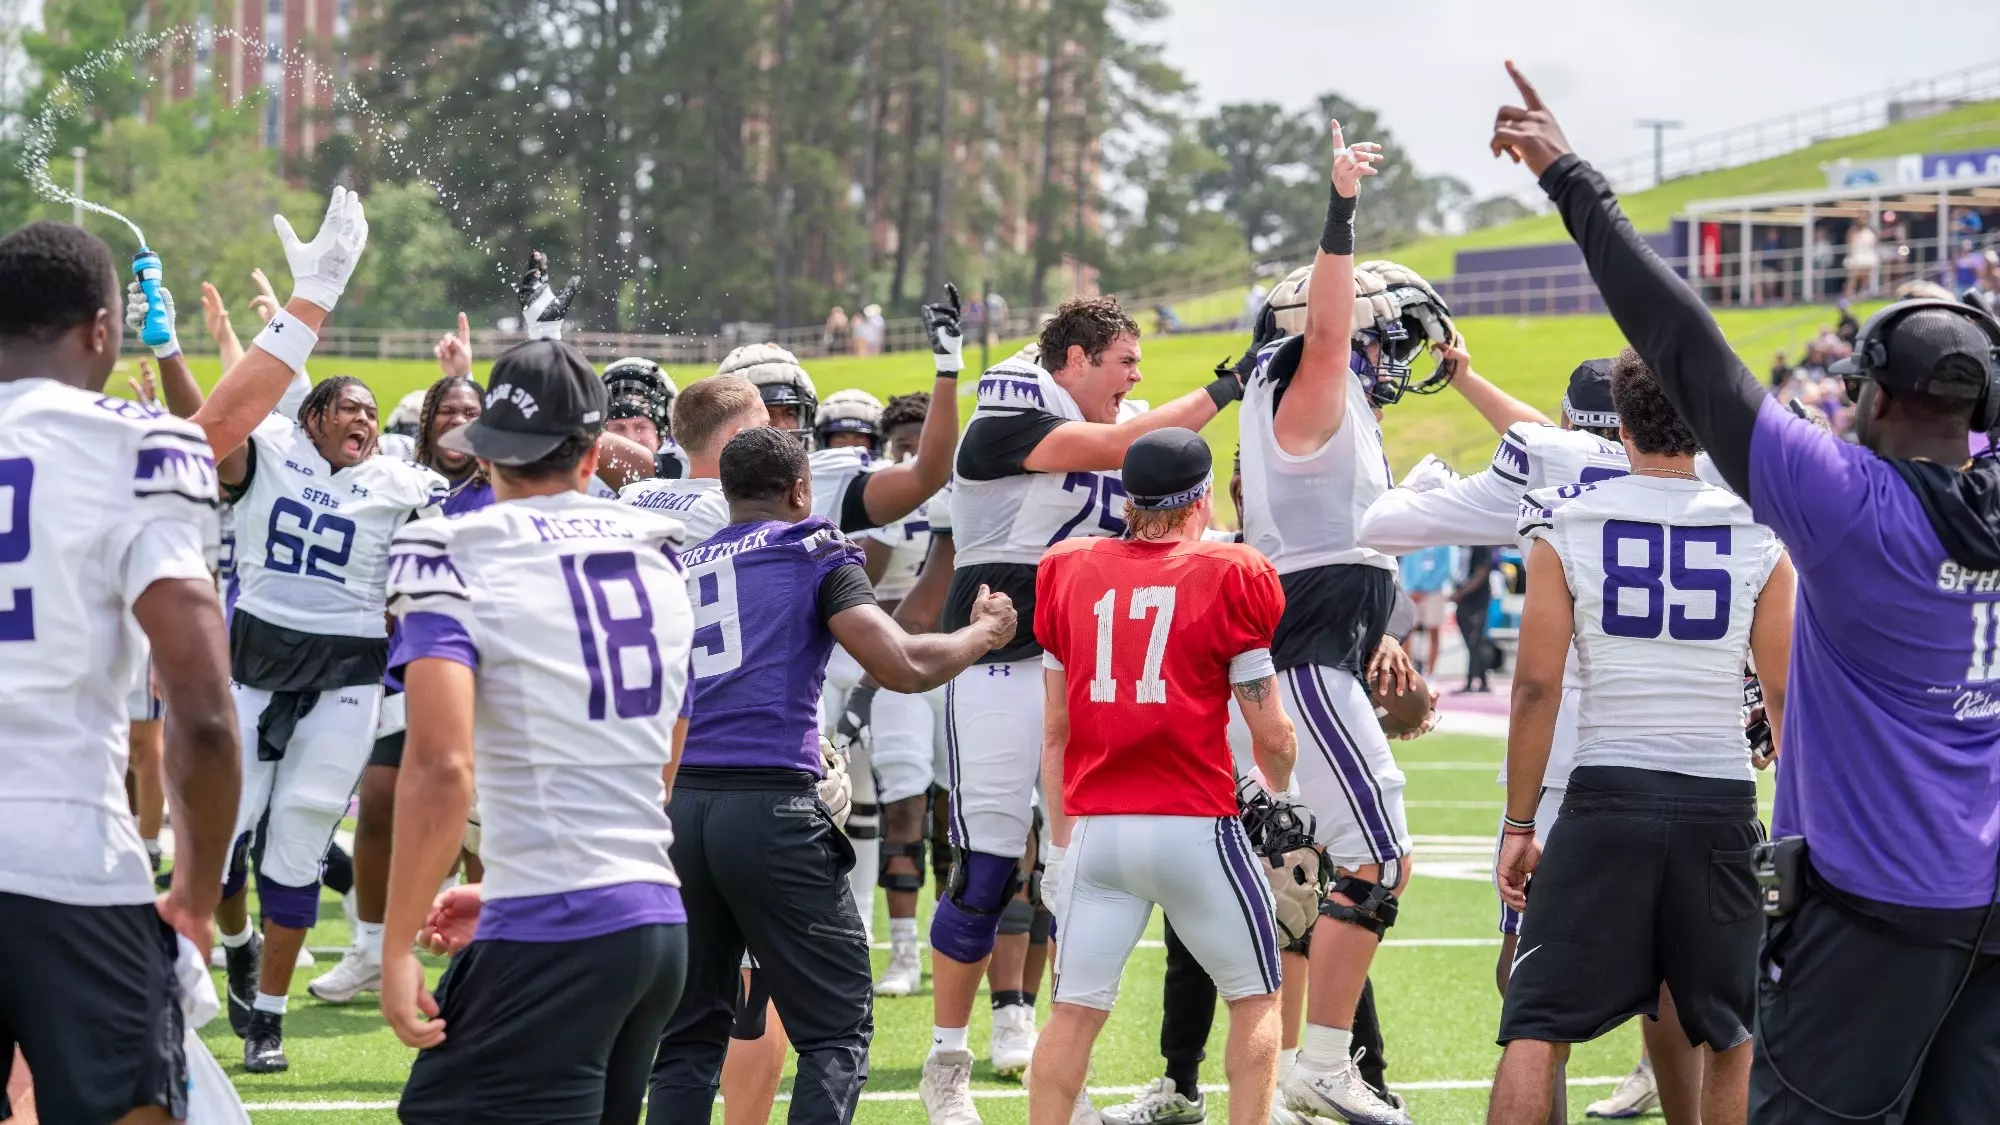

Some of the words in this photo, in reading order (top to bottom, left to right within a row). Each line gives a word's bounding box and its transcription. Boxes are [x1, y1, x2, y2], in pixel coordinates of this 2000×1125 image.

[264, 496, 356, 585] 62
[528, 514, 634, 542] MEEKS
[631, 489, 703, 512] SARRATT
[1601, 518, 1732, 641] 85
[558, 551, 663, 721] 18
[1089, 585, 1177, 704] 17
